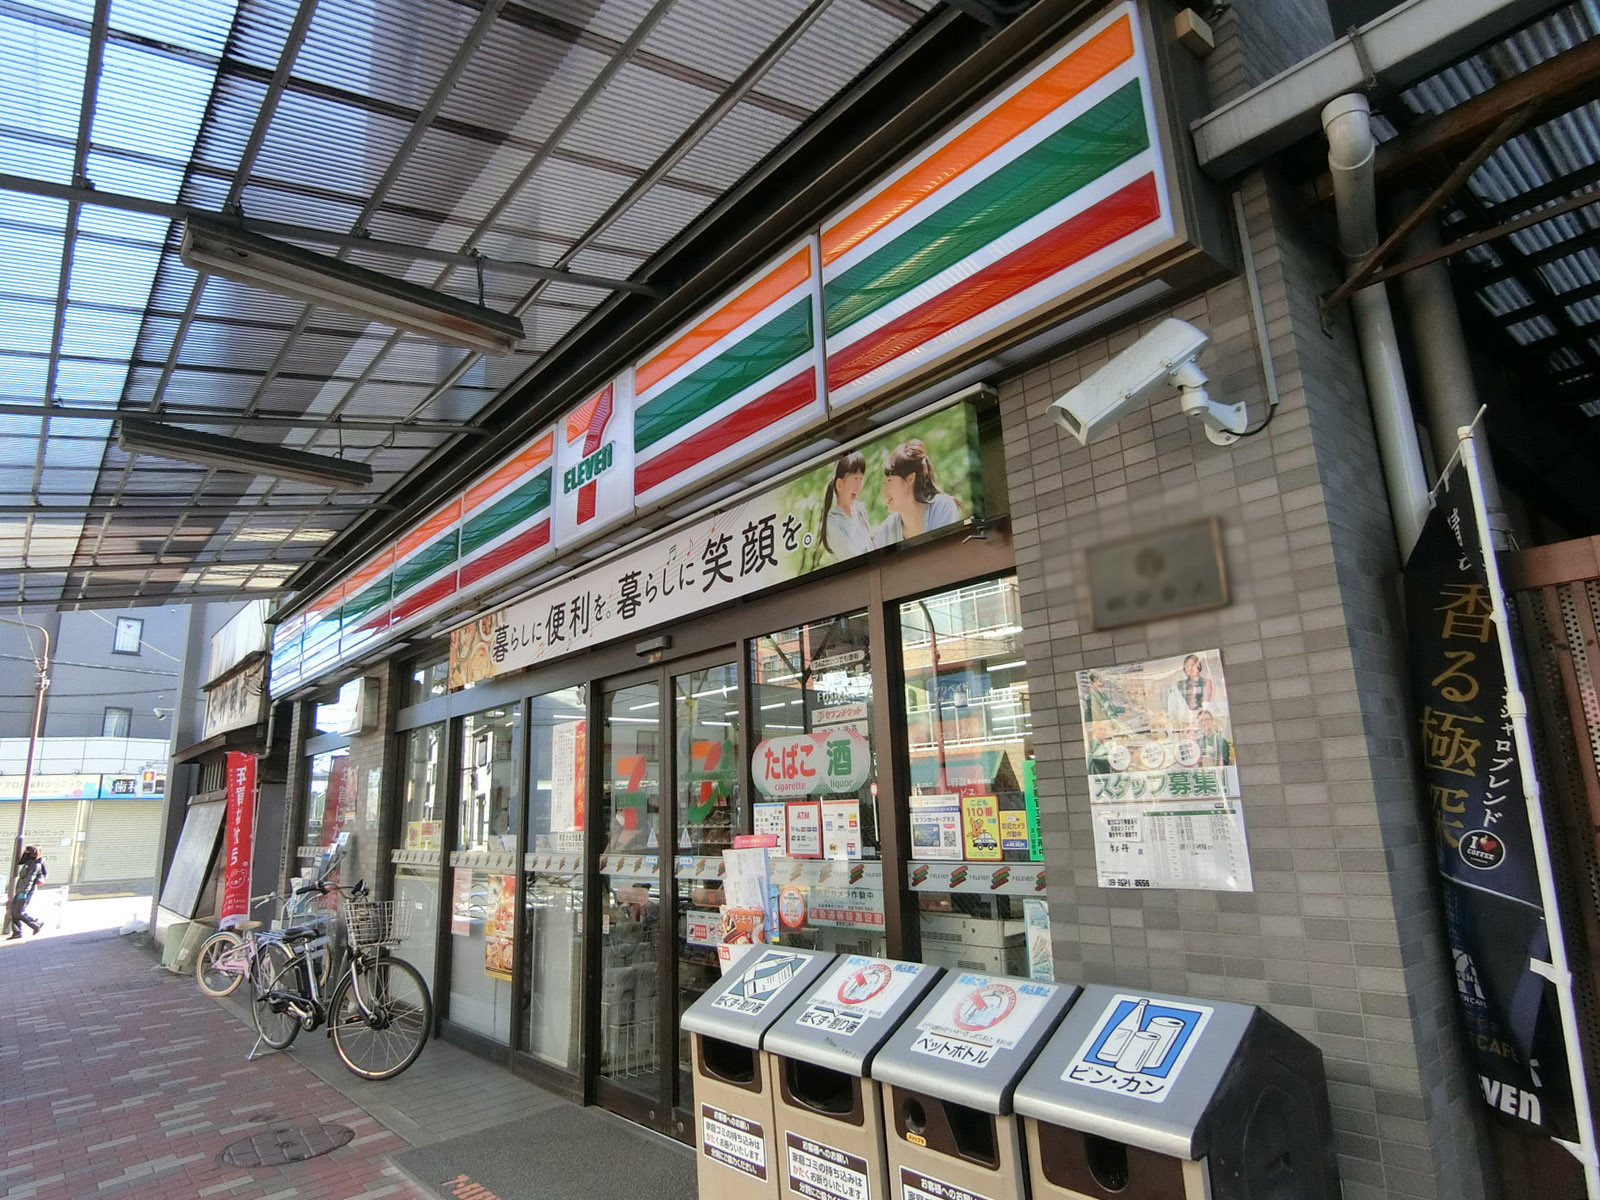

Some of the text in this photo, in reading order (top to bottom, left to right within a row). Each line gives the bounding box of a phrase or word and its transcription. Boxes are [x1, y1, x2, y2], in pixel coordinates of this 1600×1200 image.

[493, 514, 813, 663] 暮らしに便利を。暮らしに笑顔を。
[765, 744, 816, 780] たばこ
[826, 739, 852, 776] 酒
[774, 782, 806, 792] cigarette
[830, 779, 853, 788] liquor
[797, 811, 810, 819] ATM
[917, 1037, 990, 1064] ペットボトル
[1069, 1065, 1164, 1095] ビン・カン
[791, 1151, 863, 1187] 家庭ゴミの持ち込みは
